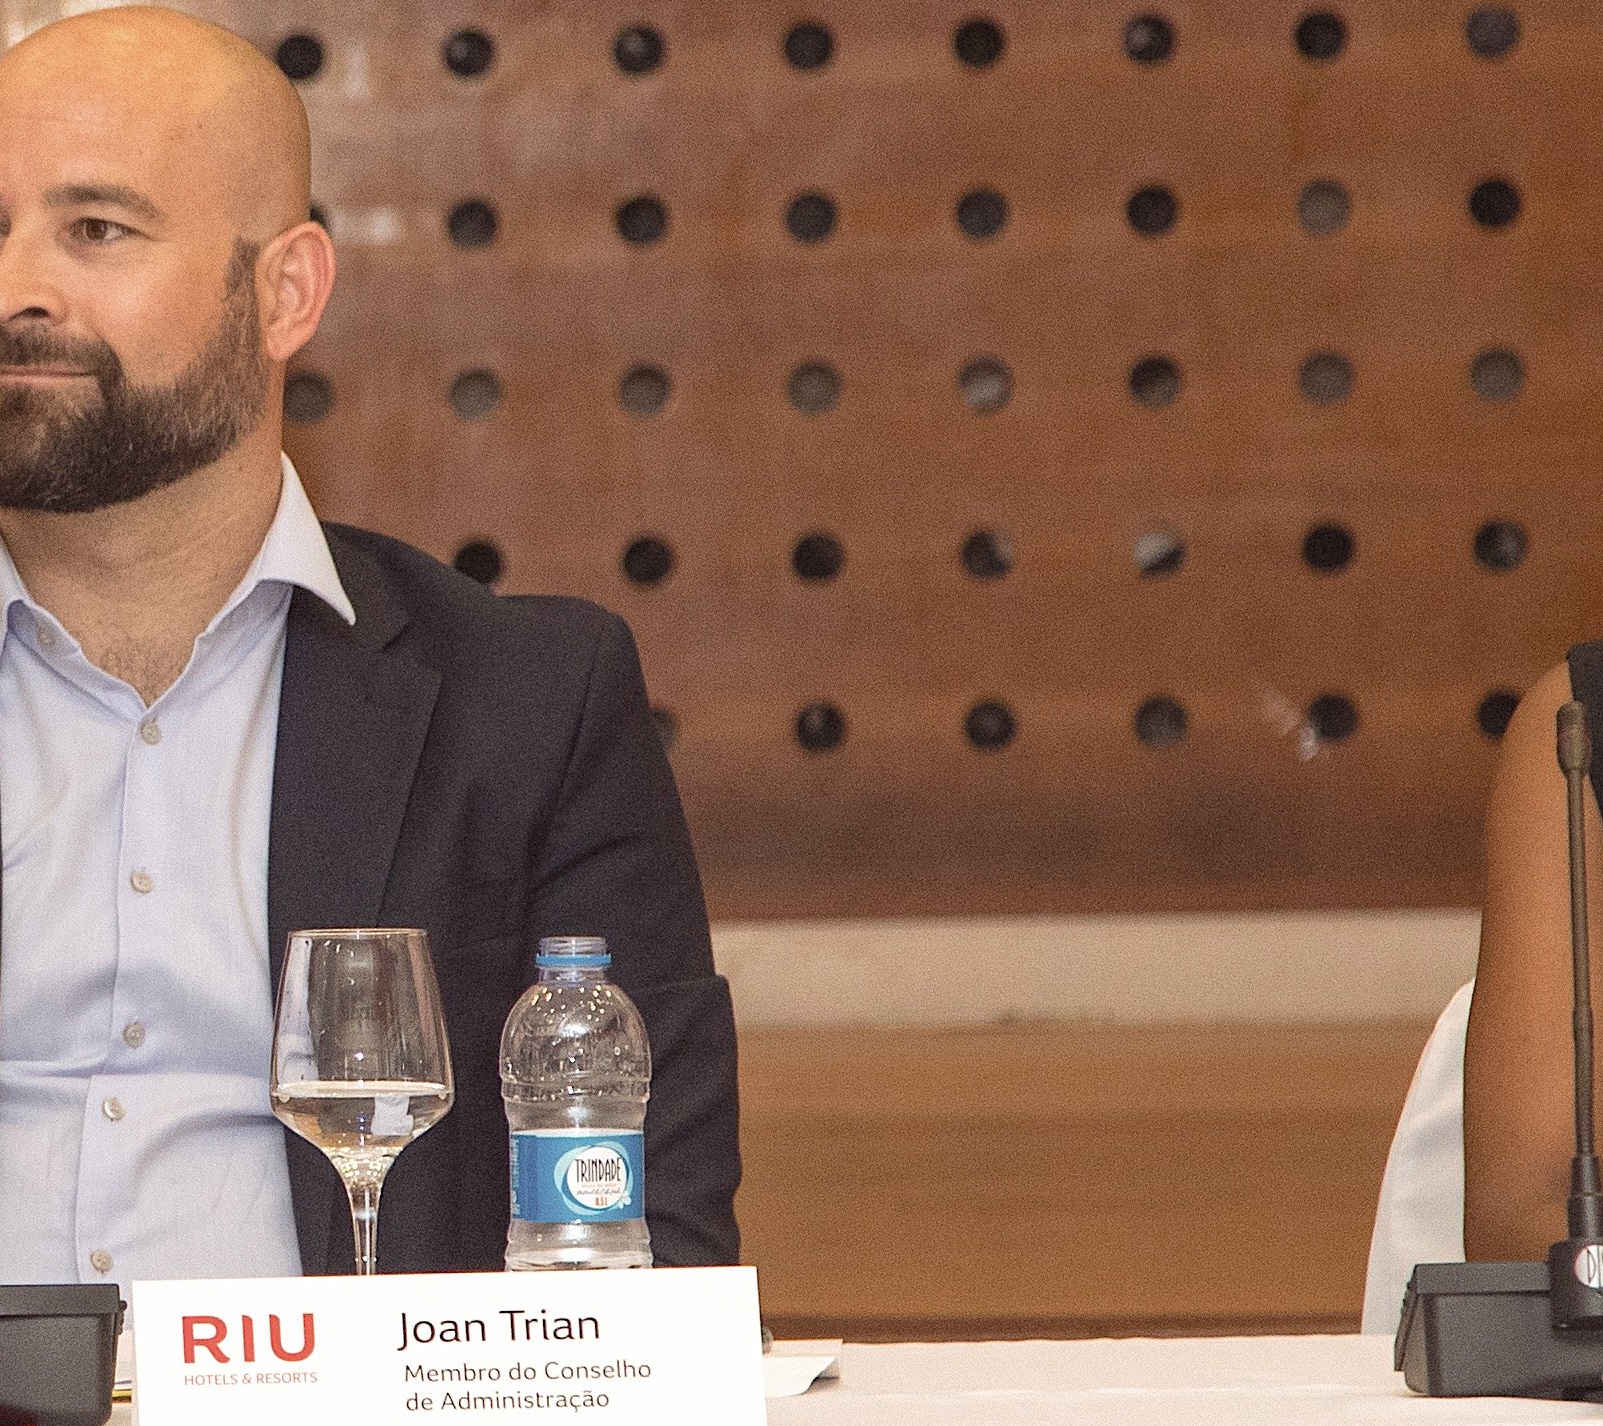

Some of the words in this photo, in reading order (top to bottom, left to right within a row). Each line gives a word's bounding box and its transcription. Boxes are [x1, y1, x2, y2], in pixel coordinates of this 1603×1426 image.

[575, 1157, 621, 1183] TRINDADE
[181, 1311, 316, 1365] RIU
[396, 1311, 487, 1352] Joan
[498, 1308, 601, 1342] Trian
[184, 1373, 238, 1386] HOTELS
[241, 1373, 252, 1385] &
[256, 1371, 318, 1384] RESORTS
[404, 1362, 501, 1383] Membro
[508, 1361, 537, 1381] do
[544, 1358, 652, 1380] Conselho
[405, 1391, 434, 1412] de
[440, 1389, 610, 1414] Administração
